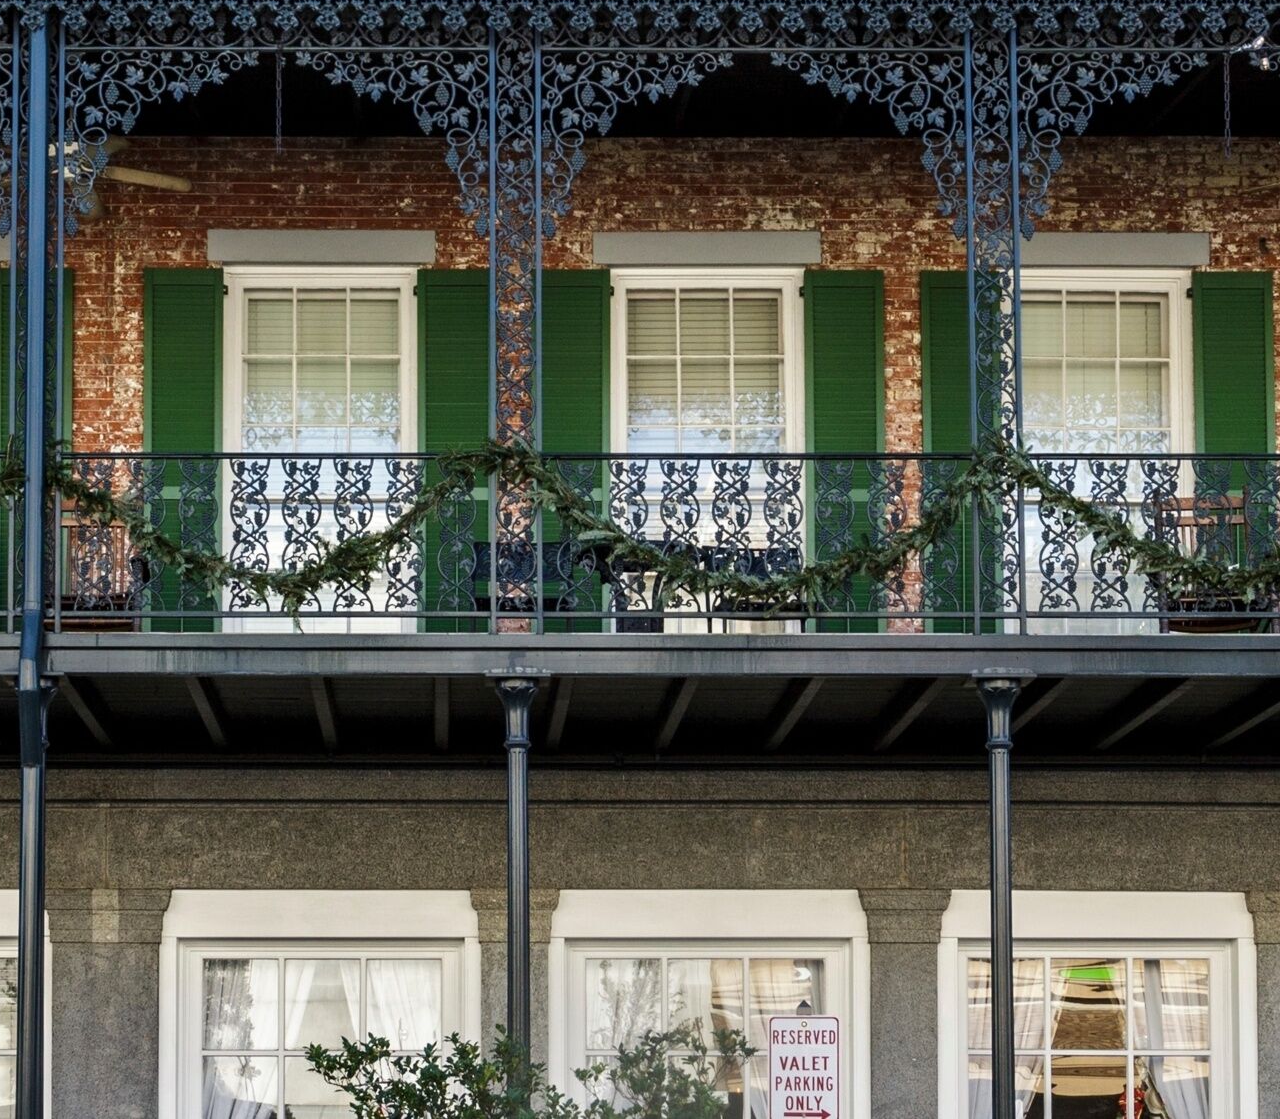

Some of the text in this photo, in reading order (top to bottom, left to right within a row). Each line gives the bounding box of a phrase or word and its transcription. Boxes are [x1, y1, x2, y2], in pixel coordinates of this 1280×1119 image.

[772, 1030, 836, 1044] RESERVED
[779, 1056, 830, 1071] VALET
[775, 1076, 833, 1091] PARKING
[785, 1096, 823, 1111] ONLY
